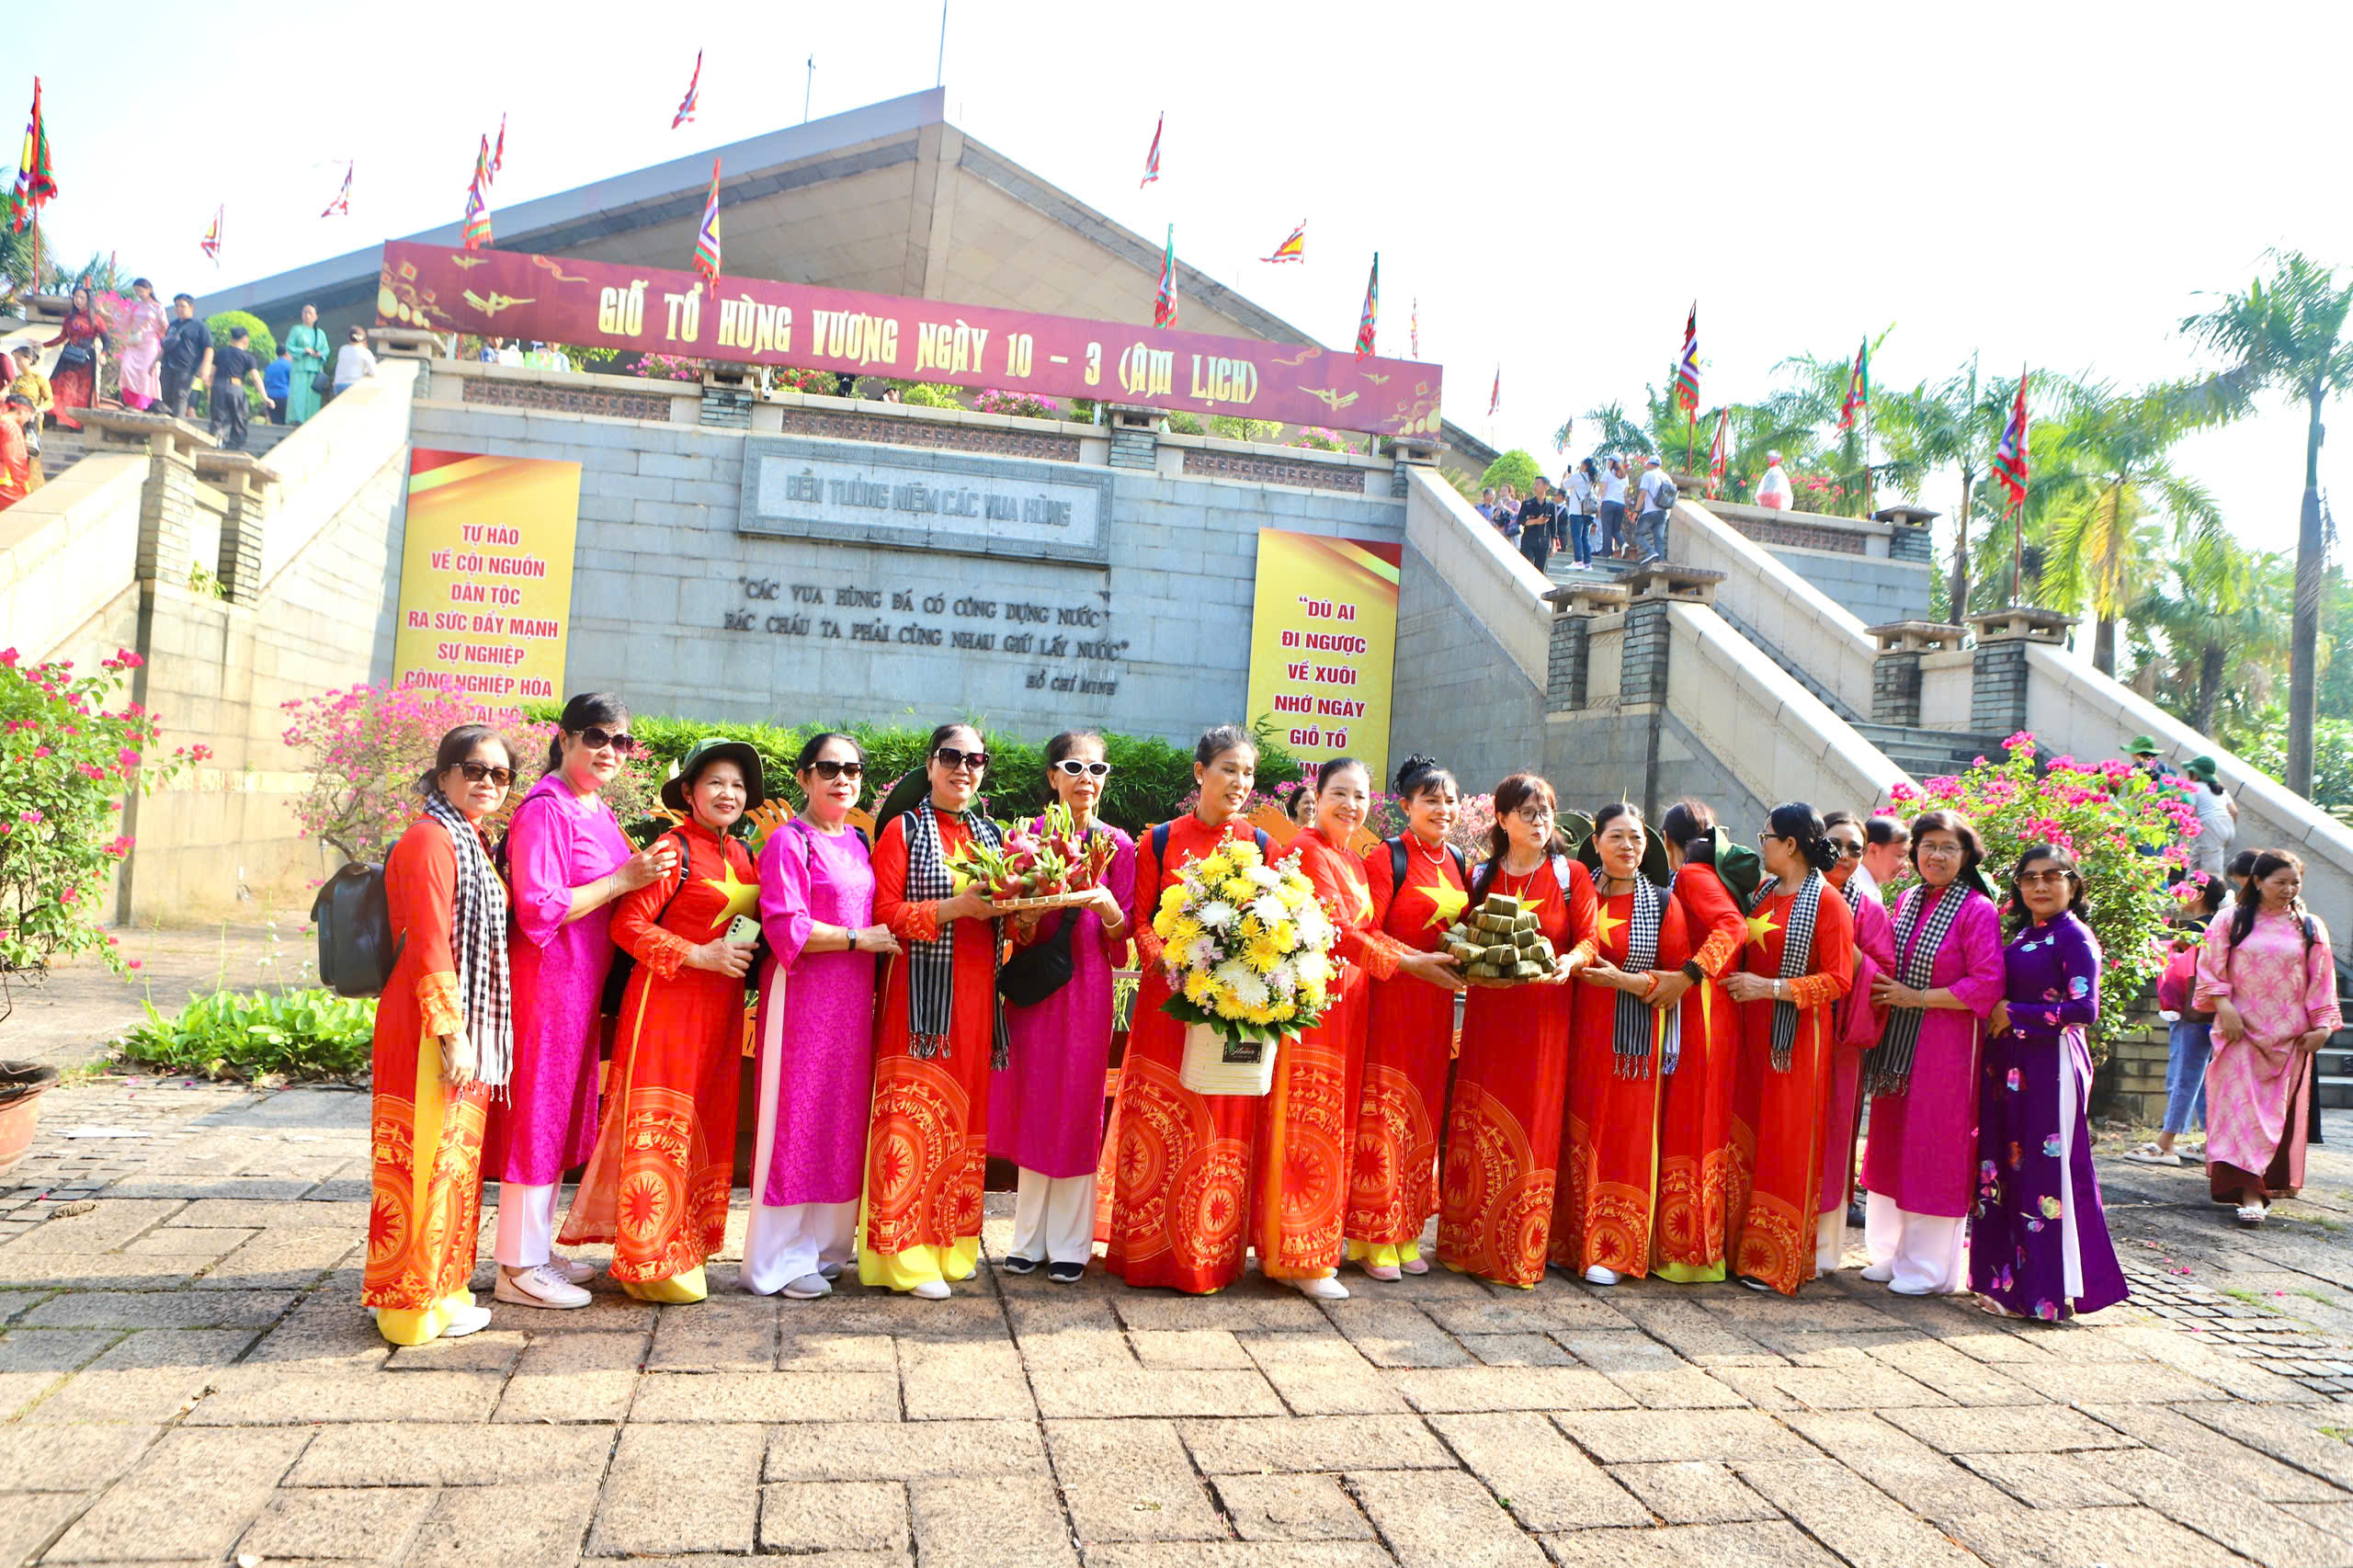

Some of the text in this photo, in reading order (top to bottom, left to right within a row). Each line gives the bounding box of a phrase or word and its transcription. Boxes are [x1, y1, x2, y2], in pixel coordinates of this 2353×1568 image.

[597, 278, 649, 337] GIỖ
[664, 281, 703, 343] TỔ
[717, 293, 792, 355] HÙNG
[812, 309, 899, 366] VƯƠNG
[914, 318, 989, 375] NGÀY
[1006, 332, 1034, 378] 10
[1084, 341, 1102, 386] 3
[1118, 340, 1175, 398] (ÂM
[1189, 353, 1258, 406] LỊCH)
[942, 486, 980, 517] CÁC
[984, 493, 1019, 522] VUA
[1022, 493, 1072, 528] HÙNG
[462, 524, 519, 547] TỰ HÀO
[432, 548, 545, 577] VỀ CỘI NGUỒN
[451, 582, 520, 608] DÂN TỘC
[790, 585, 824, 604] VUA
[835, 585, 882, 608] HÙNG
[923, 592, 946, 615] CÓ
[1005, 603, 1050, 625] DỰNG
[1336, 604, 1356, 620] AI
[408, 610, 429, 629] RA
[435, 610, 468, 631] SỨC
[509, 619, 559, 640] MẠNH
[766, 611, 811, 636] CHÁU
[821, 620, 842, 639] TA
[851, 617, 891, 642] PHẢI
[951, 631, 995, 651] NHAU
[438, 643, 525, 668] SỰ NGHIỆP
[1281, 631, 1367, 656] ĐI NGƯỢC
[1288, 660, 1358, 685] VỀ XUÔI
[519, 676, 552, 698] HÓA
[1274, 694, 1366, 718] NHỚ NGÀY
[1290, 724, 1347, 749] GIỖ TỔ
